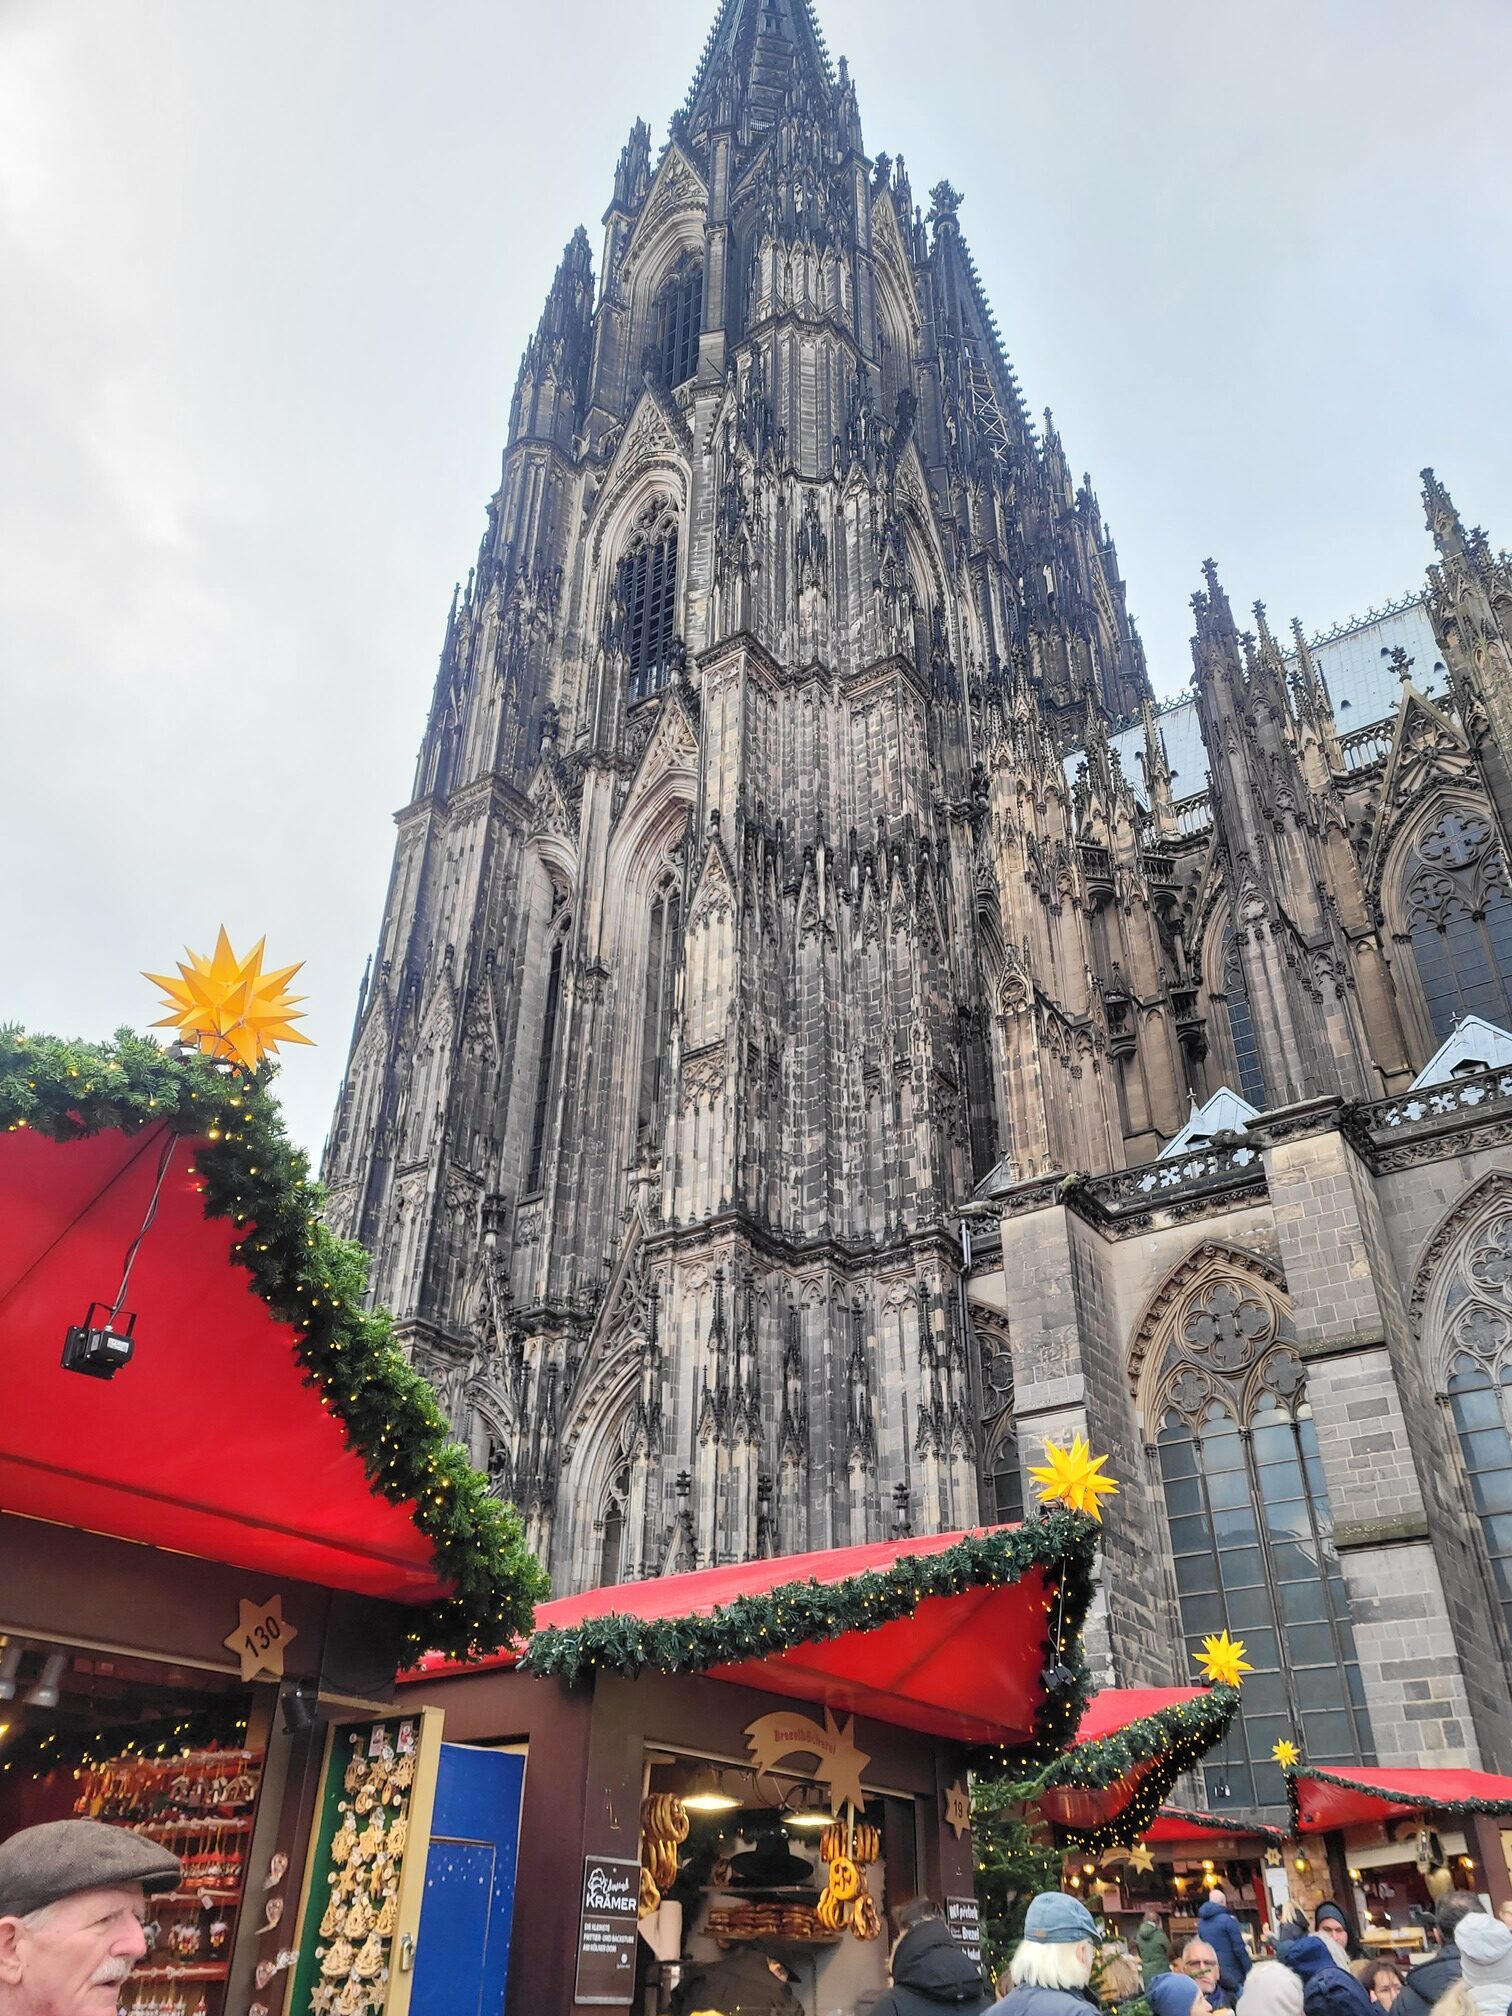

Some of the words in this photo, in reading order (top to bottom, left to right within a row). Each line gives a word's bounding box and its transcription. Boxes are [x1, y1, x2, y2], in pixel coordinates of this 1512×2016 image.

[244, 1615, 281, 1658] 130
[953, 1799, 963, 1819] 19
[586, 1892, 637, 1911] KRÄMER
